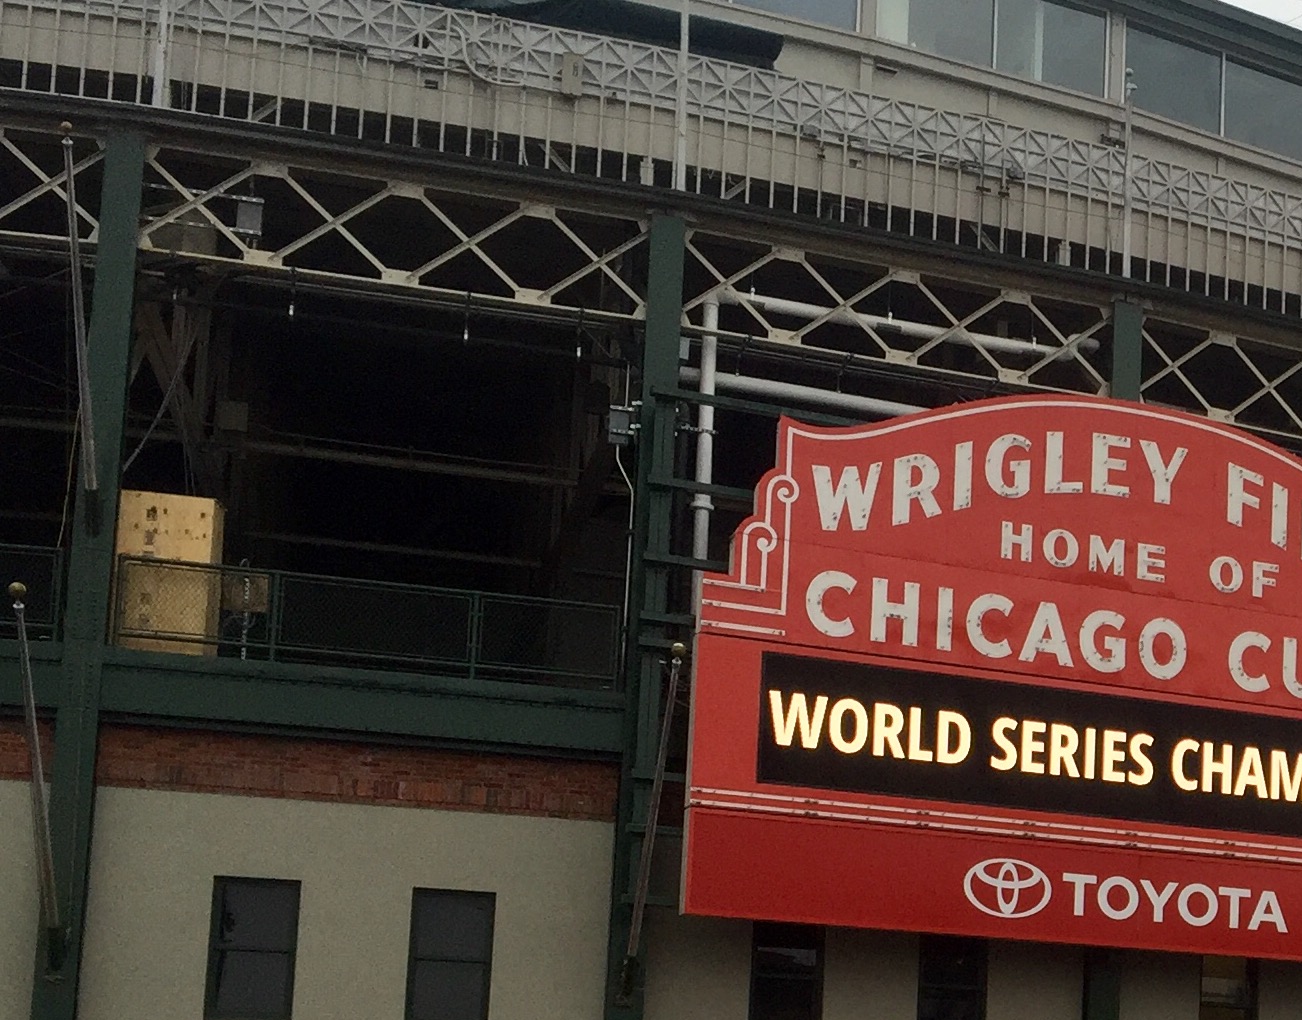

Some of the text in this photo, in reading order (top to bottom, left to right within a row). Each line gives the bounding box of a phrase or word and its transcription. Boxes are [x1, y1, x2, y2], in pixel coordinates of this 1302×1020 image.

[811, 431, 1188, 531] WRIGLEY
[1000, 521, 1279, 597] HOME OF
[805, 570, 1187, 680] CHICAGO
[769, 690, 972, 765] WORLD
[990, 716, 1155, 786] SERIES
[1063, 872, 1288, 934] TOYOTA
